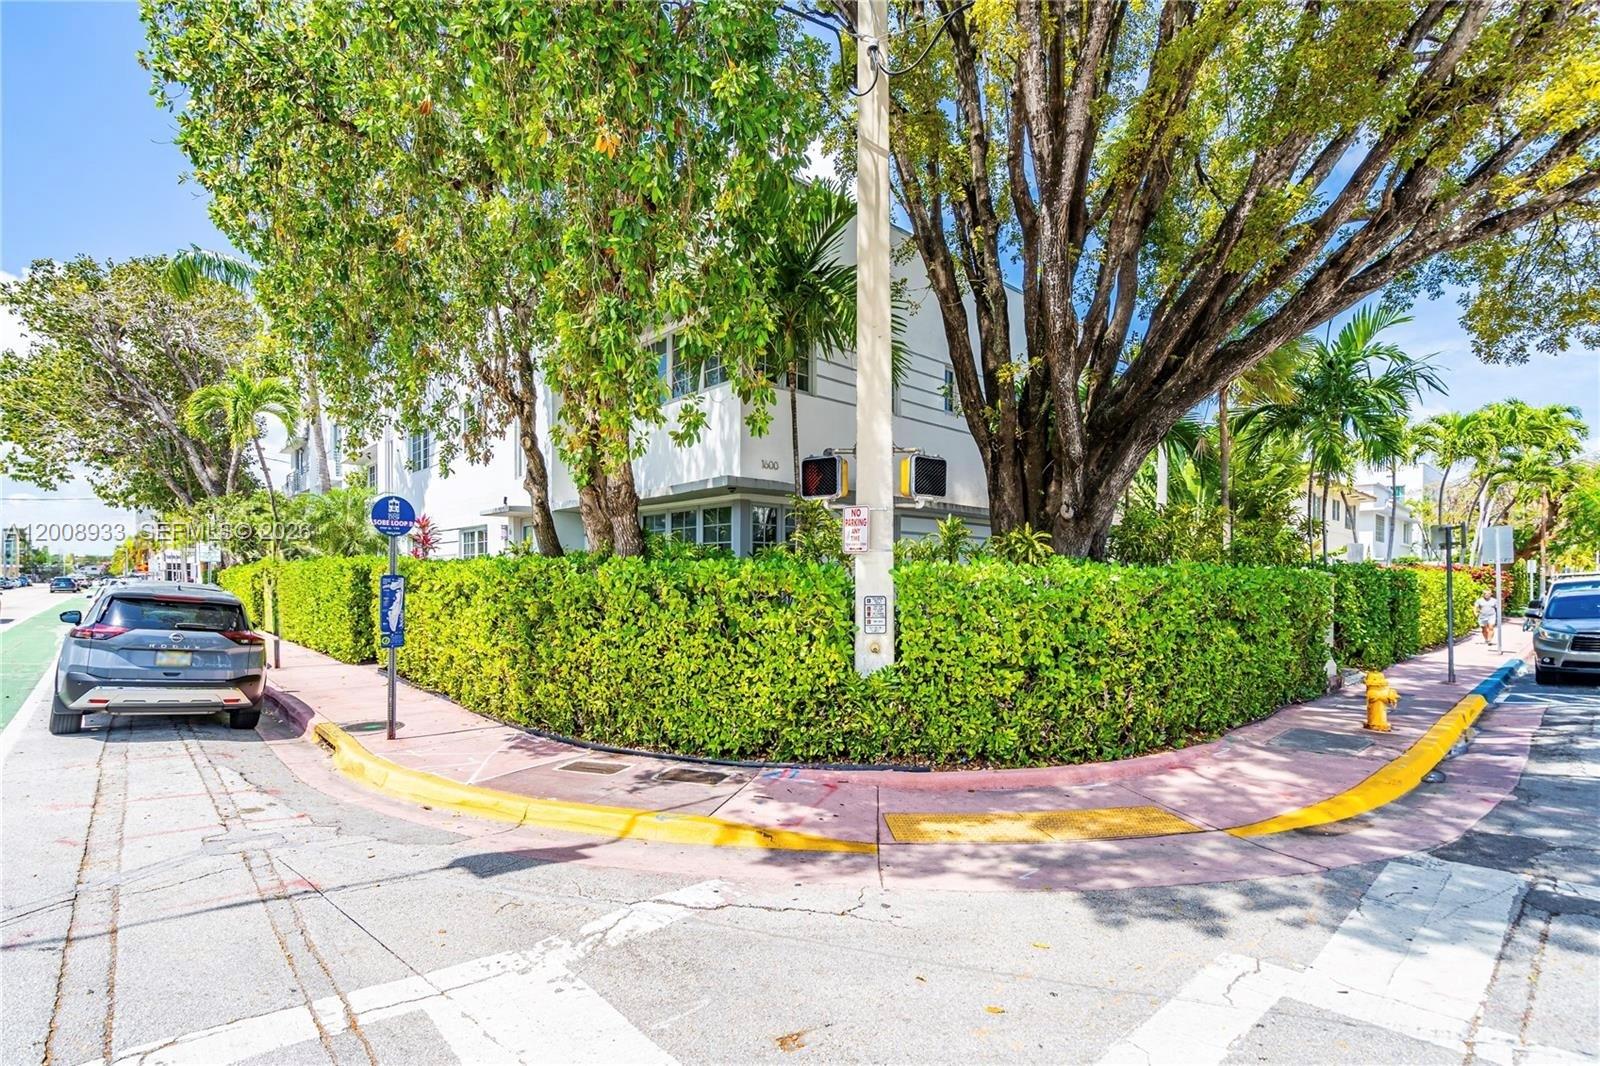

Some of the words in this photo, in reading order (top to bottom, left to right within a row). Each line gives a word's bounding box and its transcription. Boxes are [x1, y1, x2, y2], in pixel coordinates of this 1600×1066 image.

[761, 459, 779, 470] 1600
[851, 509, 861, 517] NO
[845, 518, 867, 526] PARKING
